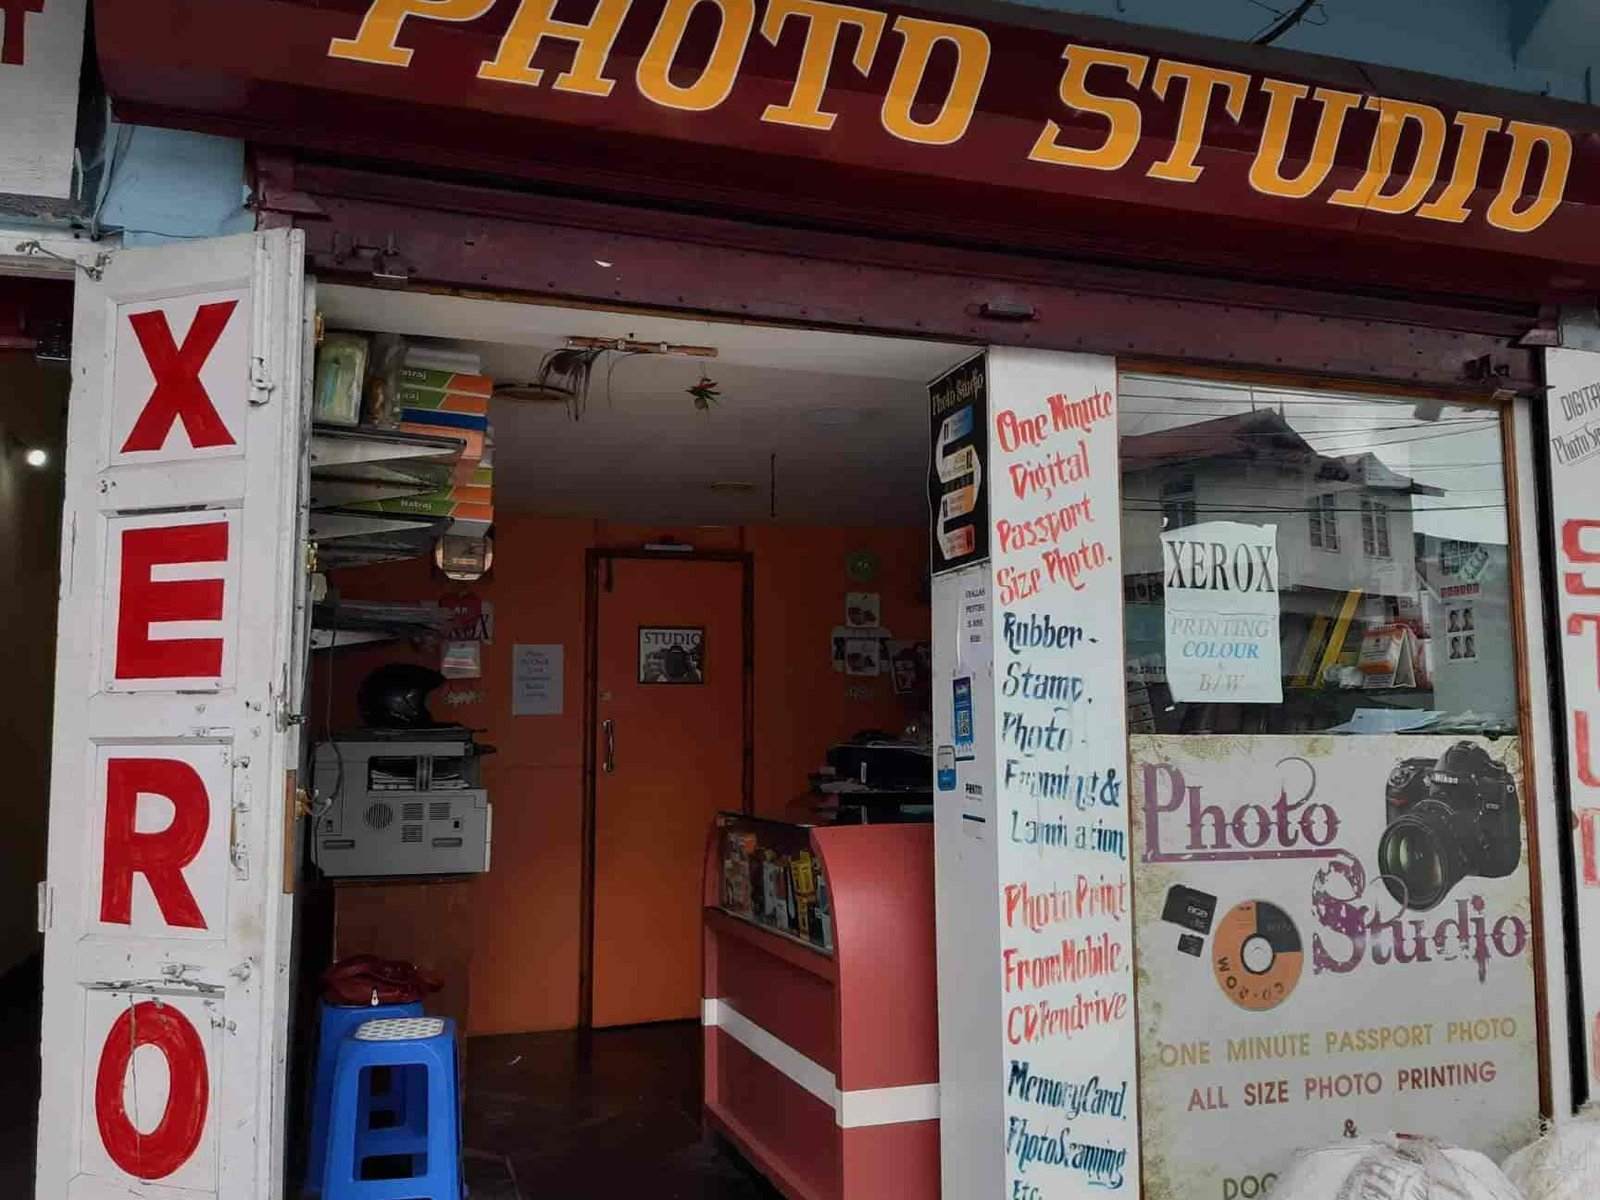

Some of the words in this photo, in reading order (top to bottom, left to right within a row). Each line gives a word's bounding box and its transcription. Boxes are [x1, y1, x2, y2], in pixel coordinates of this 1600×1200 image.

[327, 0, 991, 145] PHOTO
[1027, 43, 1573, 232] STUDIO
[996, 410, 1049, 453] One
[1047, 385, 1113, 434] Minute
[1009, 439, 1090, 500] Digital
[996, 493, 1095, 553] Passport
[997, 566, 1042, 607] Size
[1042, 539, 1113, 591] Photo.
[1166, 540, 1276, 593] XEROX
[644, 631, 701, 645] STUDIO
[1171, 617, 1270, 637] PRINTING
[1183, 641, 1260, 659] COLOUR
[1100, 768, 1121, 808] &
[1434, 772, 1459, 785] Nikon
[1141, 757, 1341, 862] Photo
[1074, 874, 1127, 922] Print
[1312, 860, 1529, 984] Studio
[1159, 1042, 1211, 1068] ONE
[1227, 1033, 1312, 1063] MINUTE
[1325, 1023, 1434, 1054] PASSPORT
[1447, 1016, 1518, 1044] PHOTO
[1187, 1088, 1229, 1112] ALL
[1243, 1080, 1290, 1107] SIZE
[1304, 1072, 1383, 1101] PHOTO
[1399, 1061, 1497, 1091] PRINTING
[1342, 1118, 1359, 1139] &
